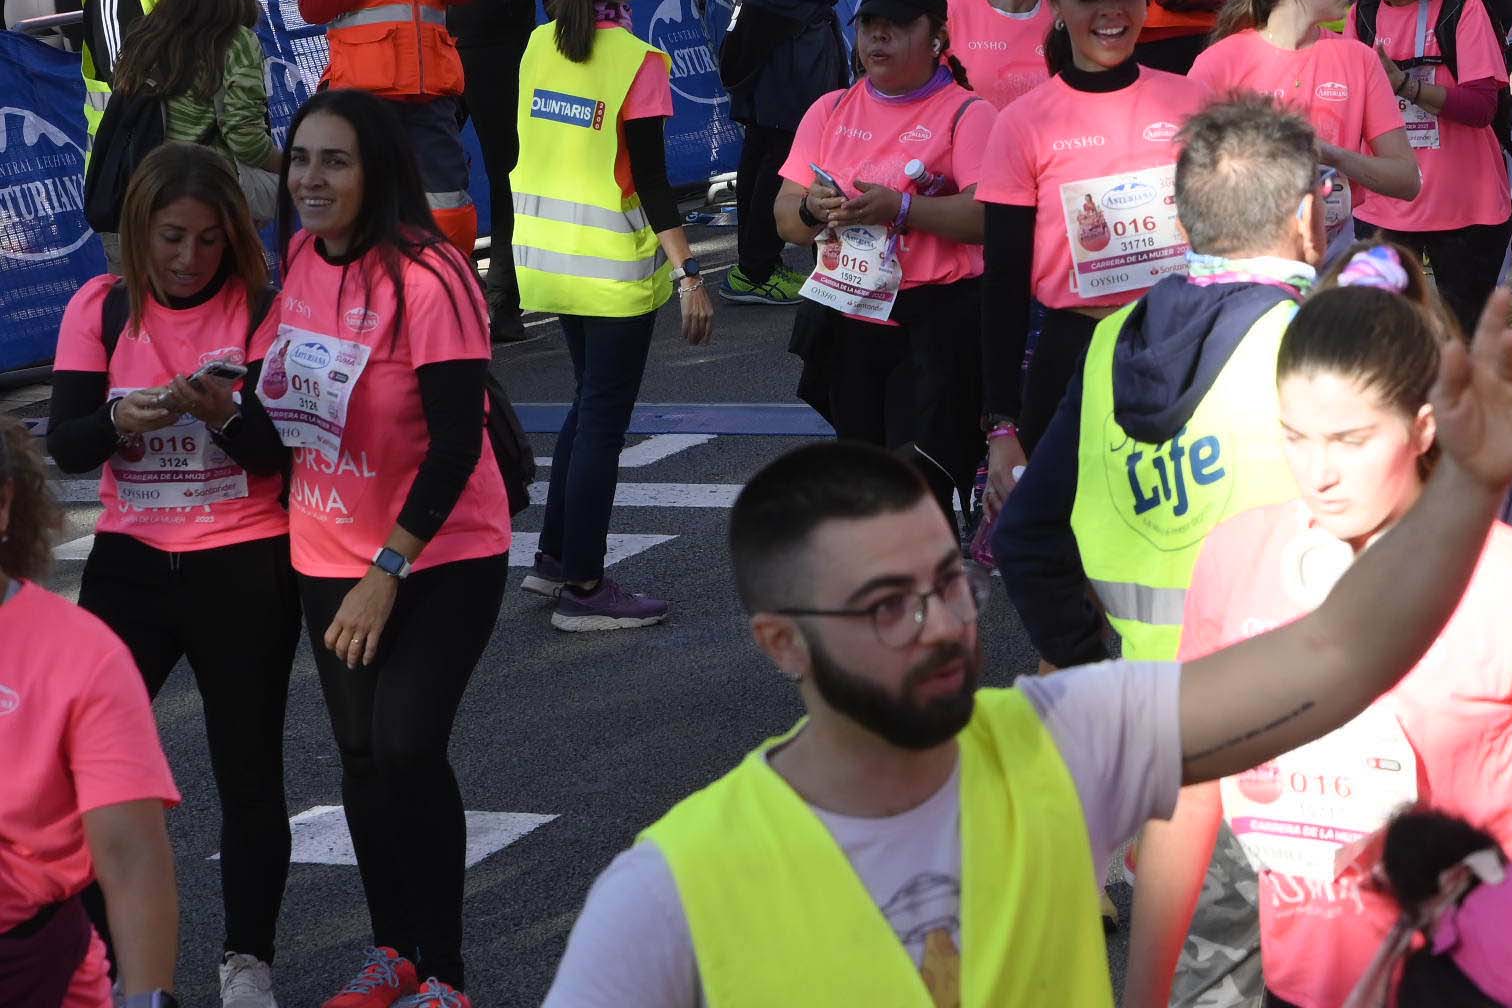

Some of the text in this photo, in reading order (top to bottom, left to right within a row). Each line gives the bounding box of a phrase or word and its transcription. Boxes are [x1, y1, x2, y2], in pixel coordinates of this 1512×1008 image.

[968, 40, 1007, 52] OYSHO
[1053, 135, 1106, 152] OYSHO
[1113, 214, 1157, 237] 016
[1120, 236, 1156, 252] 31718
[841, 253, 869, 274] 016
[1090, 255, 1126, 270] CARRERA
[1127, 253, 1138, 264] DE
[1138, 252, 1149, 263] LA
[1149, 248, 1175, 260] MUJER
[840, 271, 863, 286] 15972
[1090, 272, 1130, 289] OYSHO
[810, 286, 838, 301] OYSHO
[291, 374, 321, 398] 016
[149, 435, 196, 453] 016
[160, 457, 189, 468] 3124
[123, 473, 158, 481] CARRERA
[160, 472, 171, 480] DE
[194, 482, 237, 498] Santander
[292, 485, 348, 515] UMA
[1289, 771, 1353, 799] 016
[1319, 826, 1335, 840] LA
